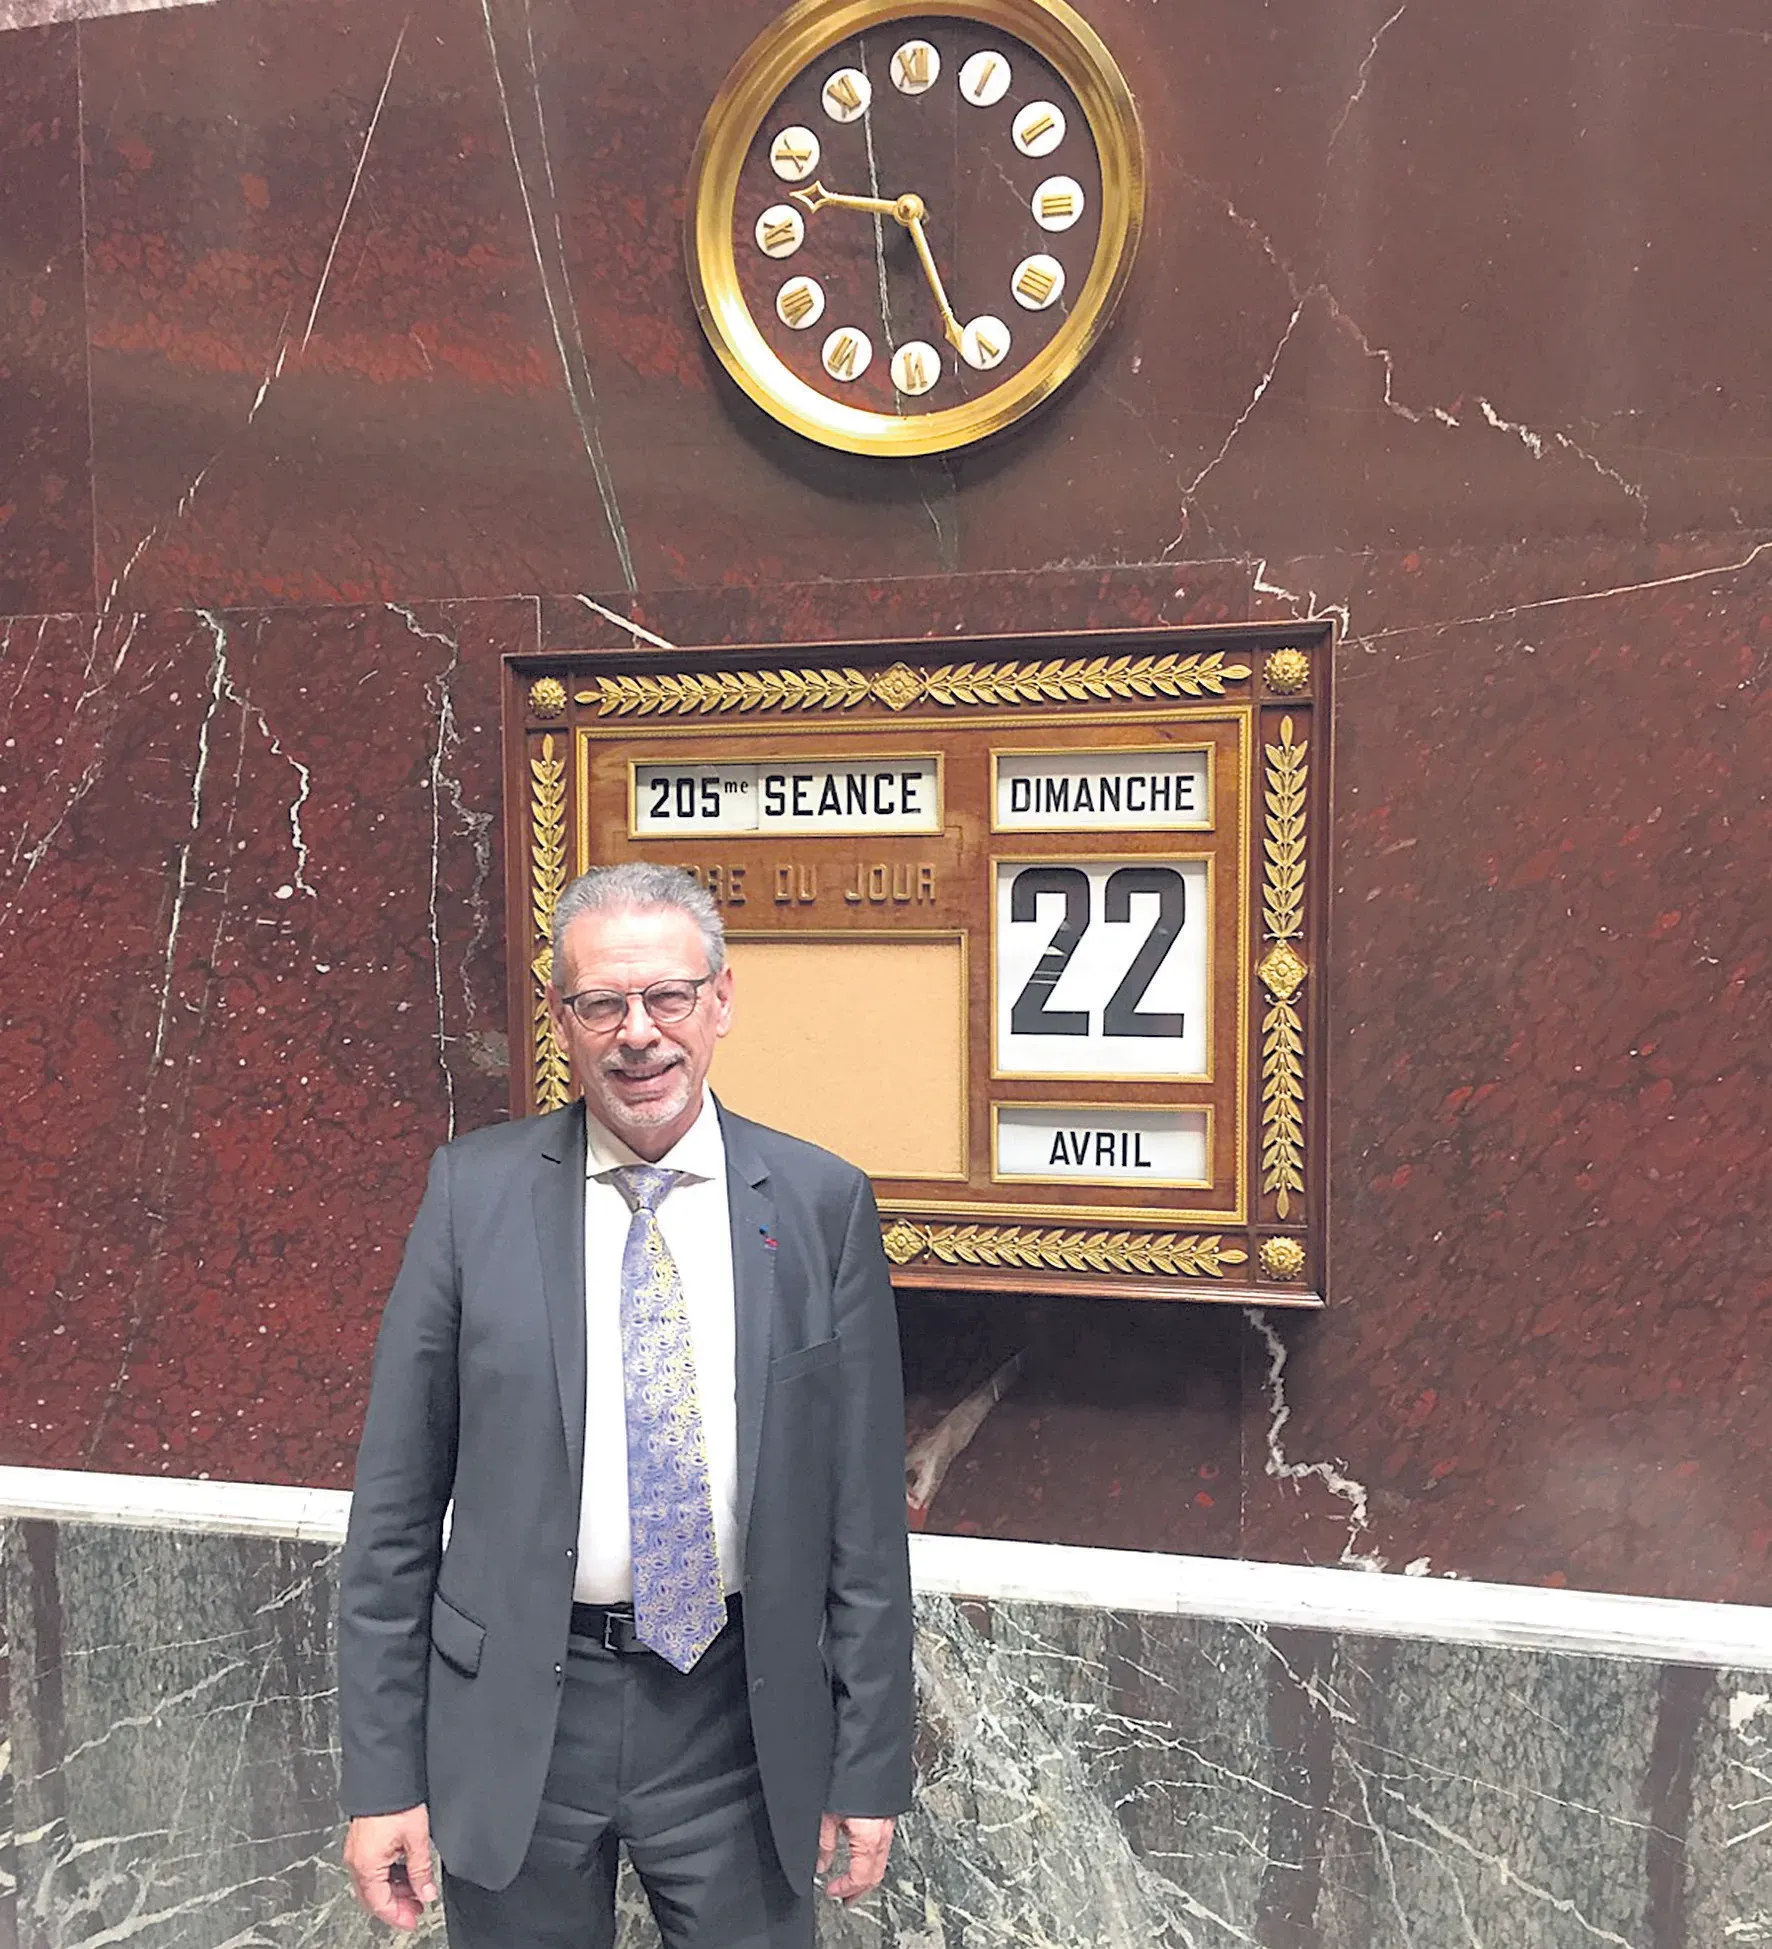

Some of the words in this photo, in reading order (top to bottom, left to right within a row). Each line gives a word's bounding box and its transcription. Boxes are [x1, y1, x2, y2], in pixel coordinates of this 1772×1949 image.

[897, 48, 929, 87] XII
[974, 60, 996, 96] I
[1021, 114, 1055, 146] II
[1041, 194, 1073, 218] III
[764, 772, 924, 817] SEANCE
[1010, 775, 1196, 814] DIMANCHE
[774, 863, 817, 905] DU
[844, 863, 937, 906] JOUR
[1011, 867, 1185, 1038] 22
[1049, 1131, 1151, 1167] AVRIL
